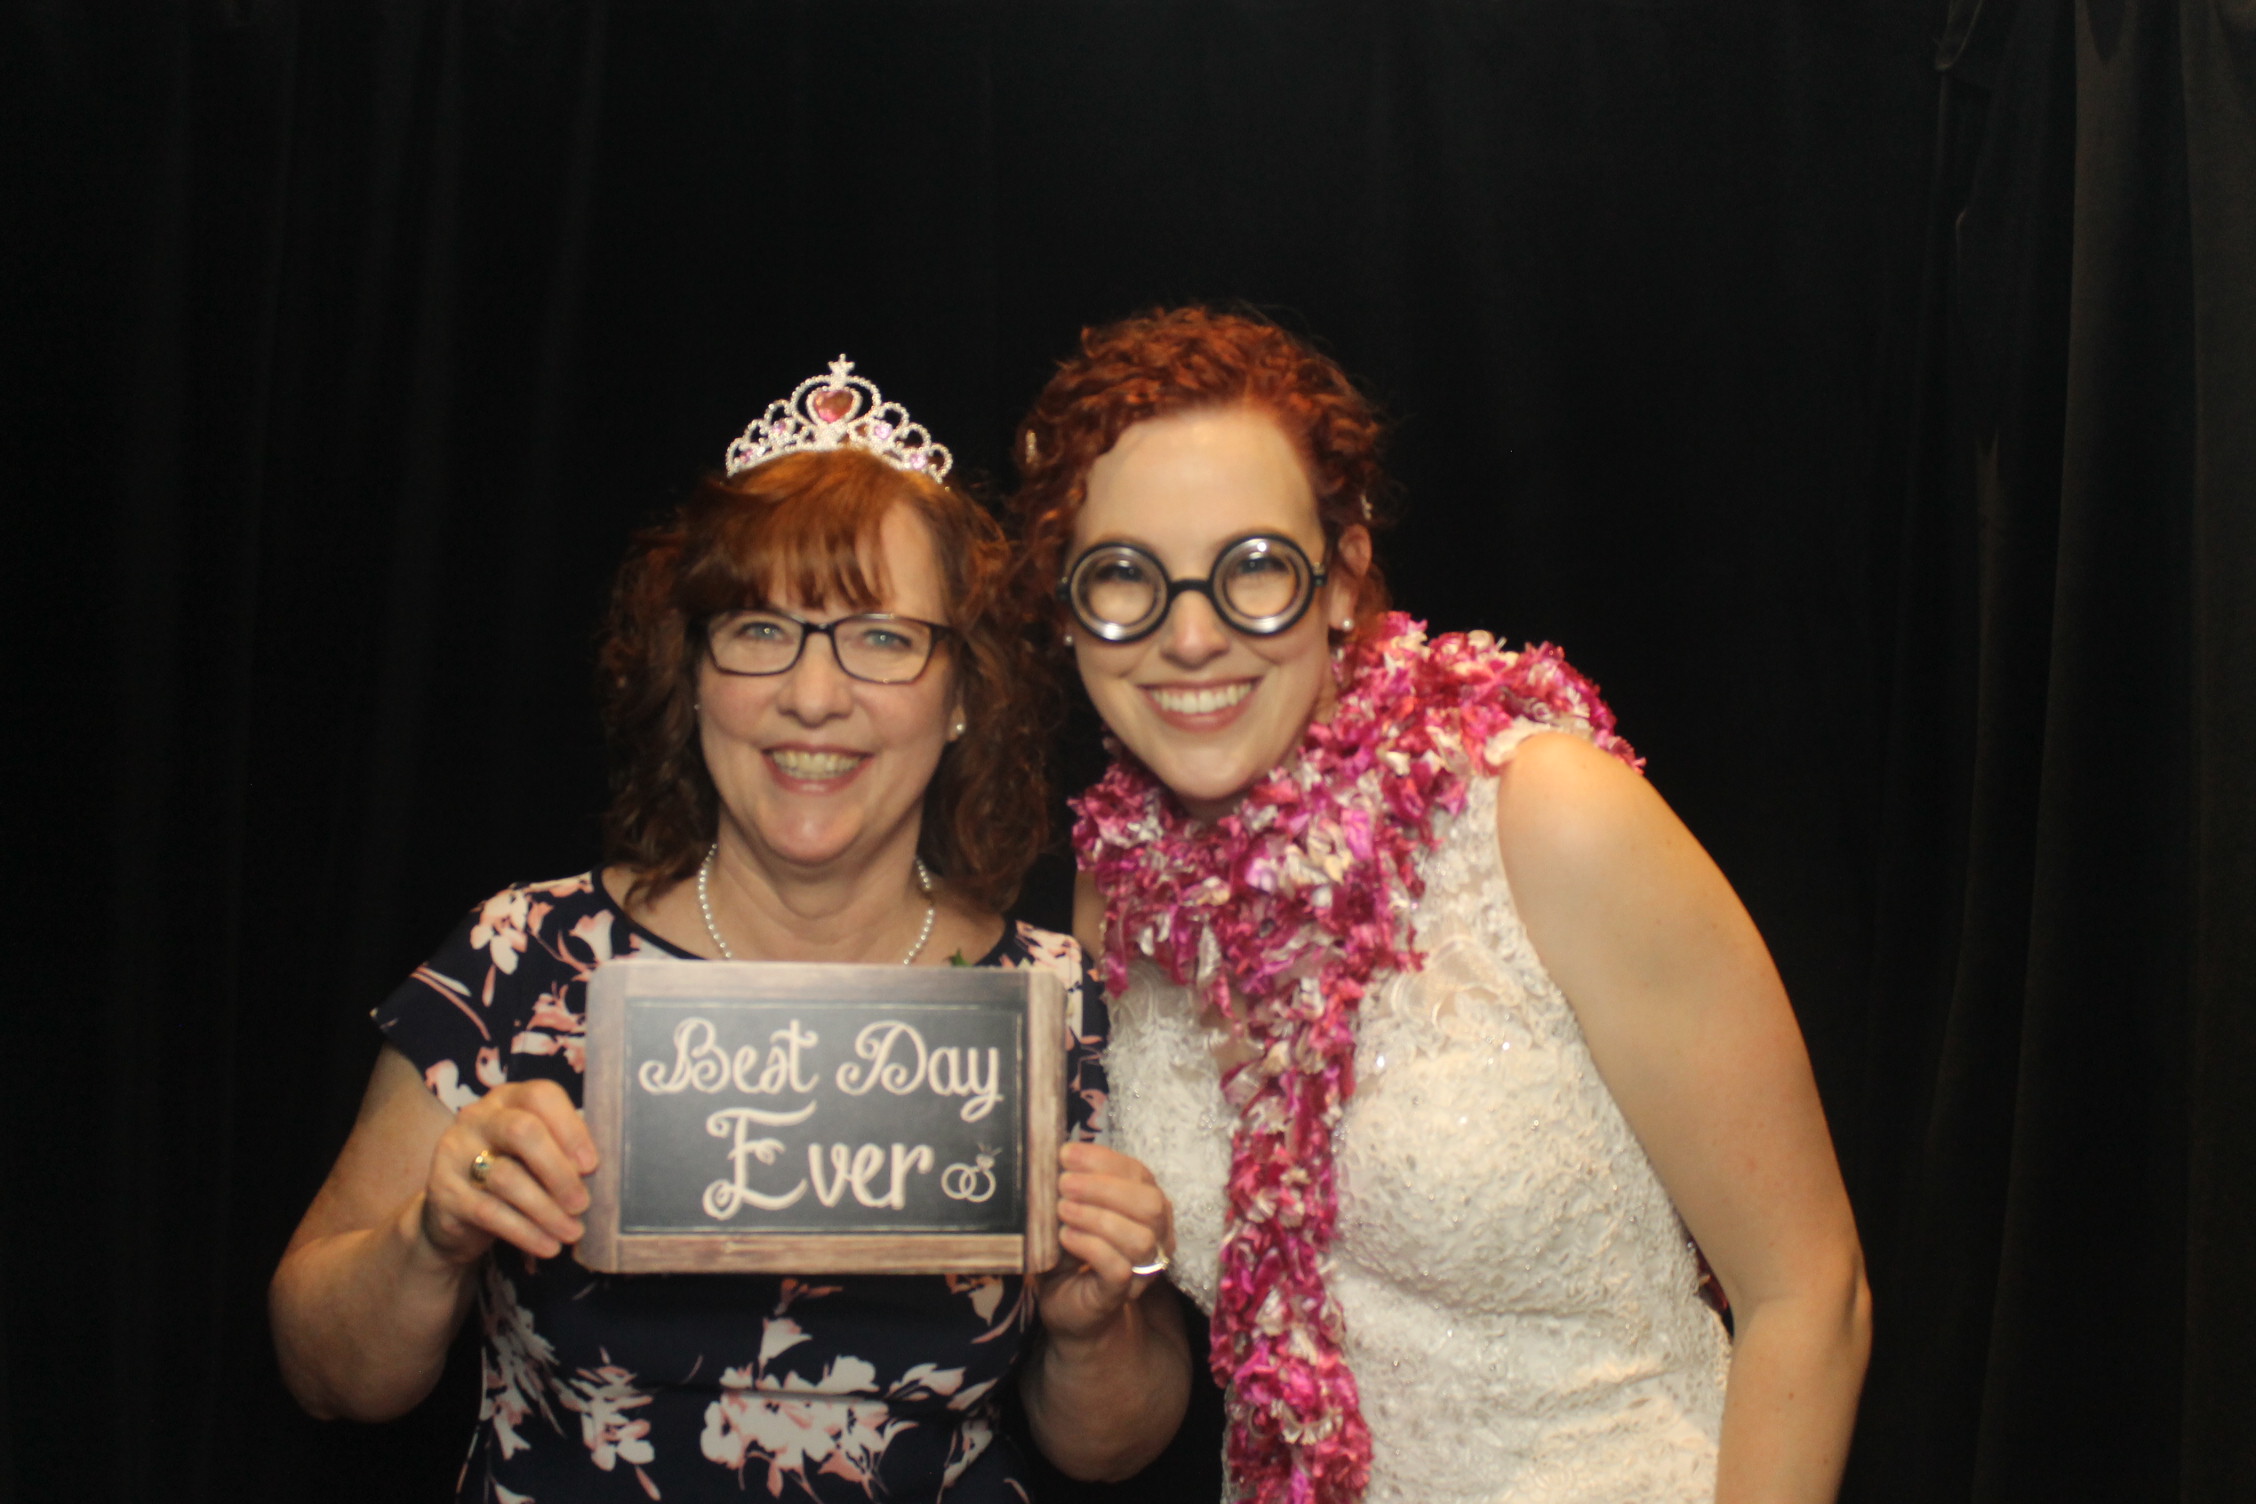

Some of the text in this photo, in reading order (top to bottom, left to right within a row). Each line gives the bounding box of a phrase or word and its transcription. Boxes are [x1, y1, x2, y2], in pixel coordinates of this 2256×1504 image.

[638, 1017, 1003, 1122] Best Day
[703, 1100, 934, 1220] Ever
